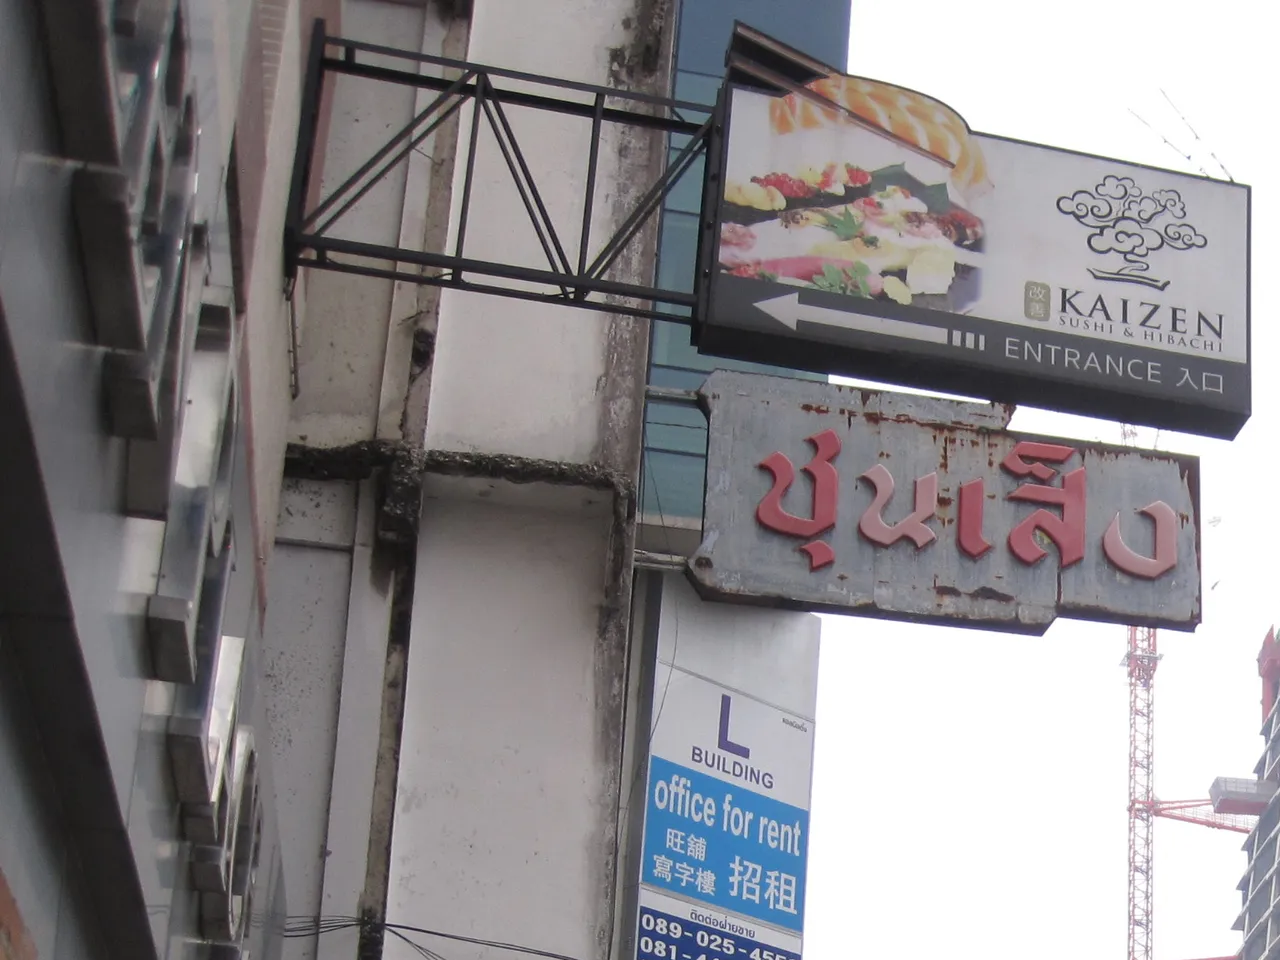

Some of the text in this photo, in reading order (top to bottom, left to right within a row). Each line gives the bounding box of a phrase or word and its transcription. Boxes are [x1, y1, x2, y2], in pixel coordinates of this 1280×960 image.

[1058, 287, 1225, 340] KAIZEN
[1058, 315, 1223, 353] SUSHI & HIBACHI
[1004, 338, 1224, 395] ENTRANCE 入口
[718, 693, 750, 760] L
[691, 746, 774, 790] BUILDING
[654, 774, 801, 857] office for rent
[729, 855, 798, 915] 招租
[690, 908, 756, 939] ติดต่อฝ่ายขาย
